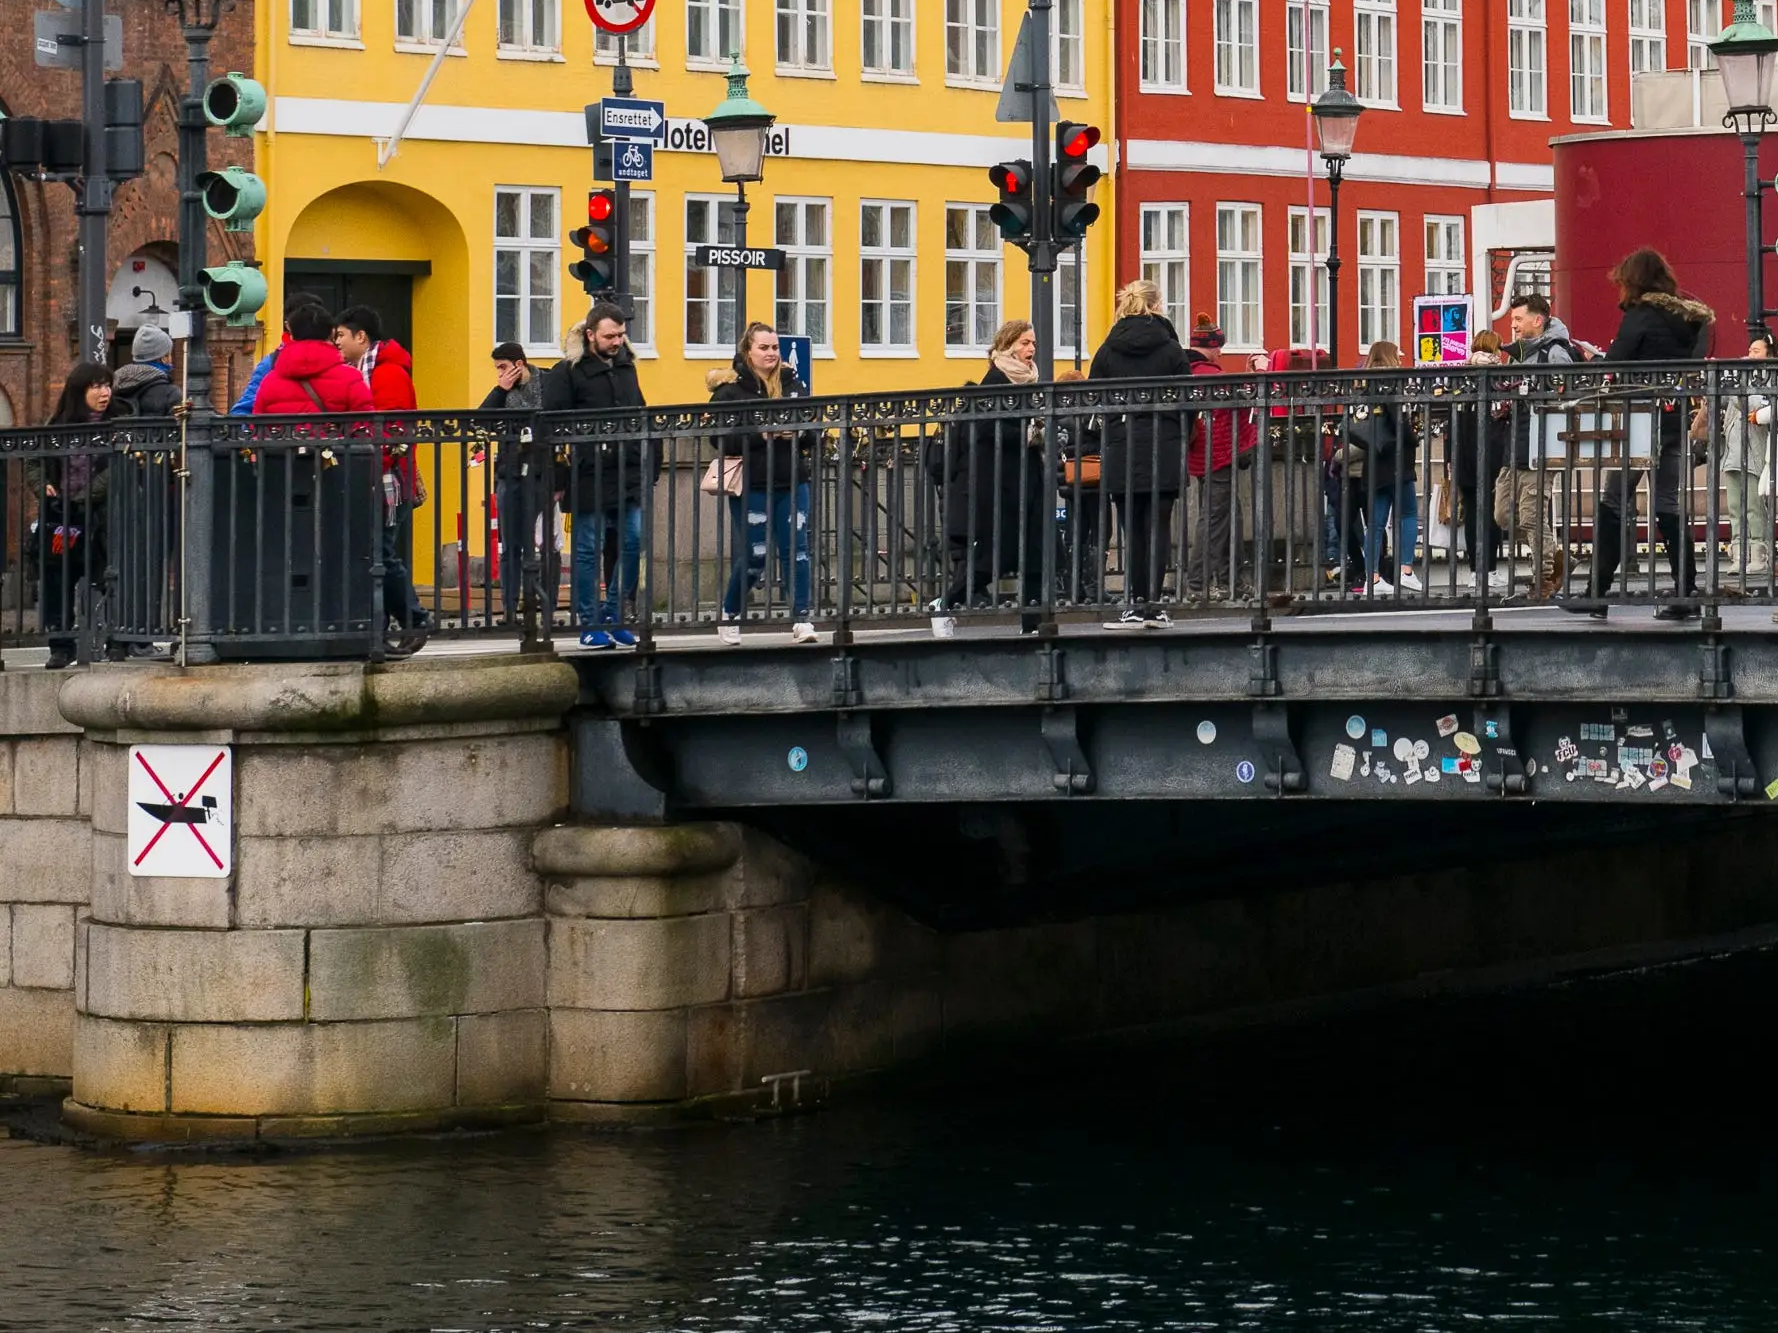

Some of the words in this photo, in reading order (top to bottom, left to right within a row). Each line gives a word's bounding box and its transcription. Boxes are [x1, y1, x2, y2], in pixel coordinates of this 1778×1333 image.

[606, 110, 652, 127] Ensrettet
[618, 168, 648, 178] undtaget
[708, 248, 766, 267] PISSOIR
